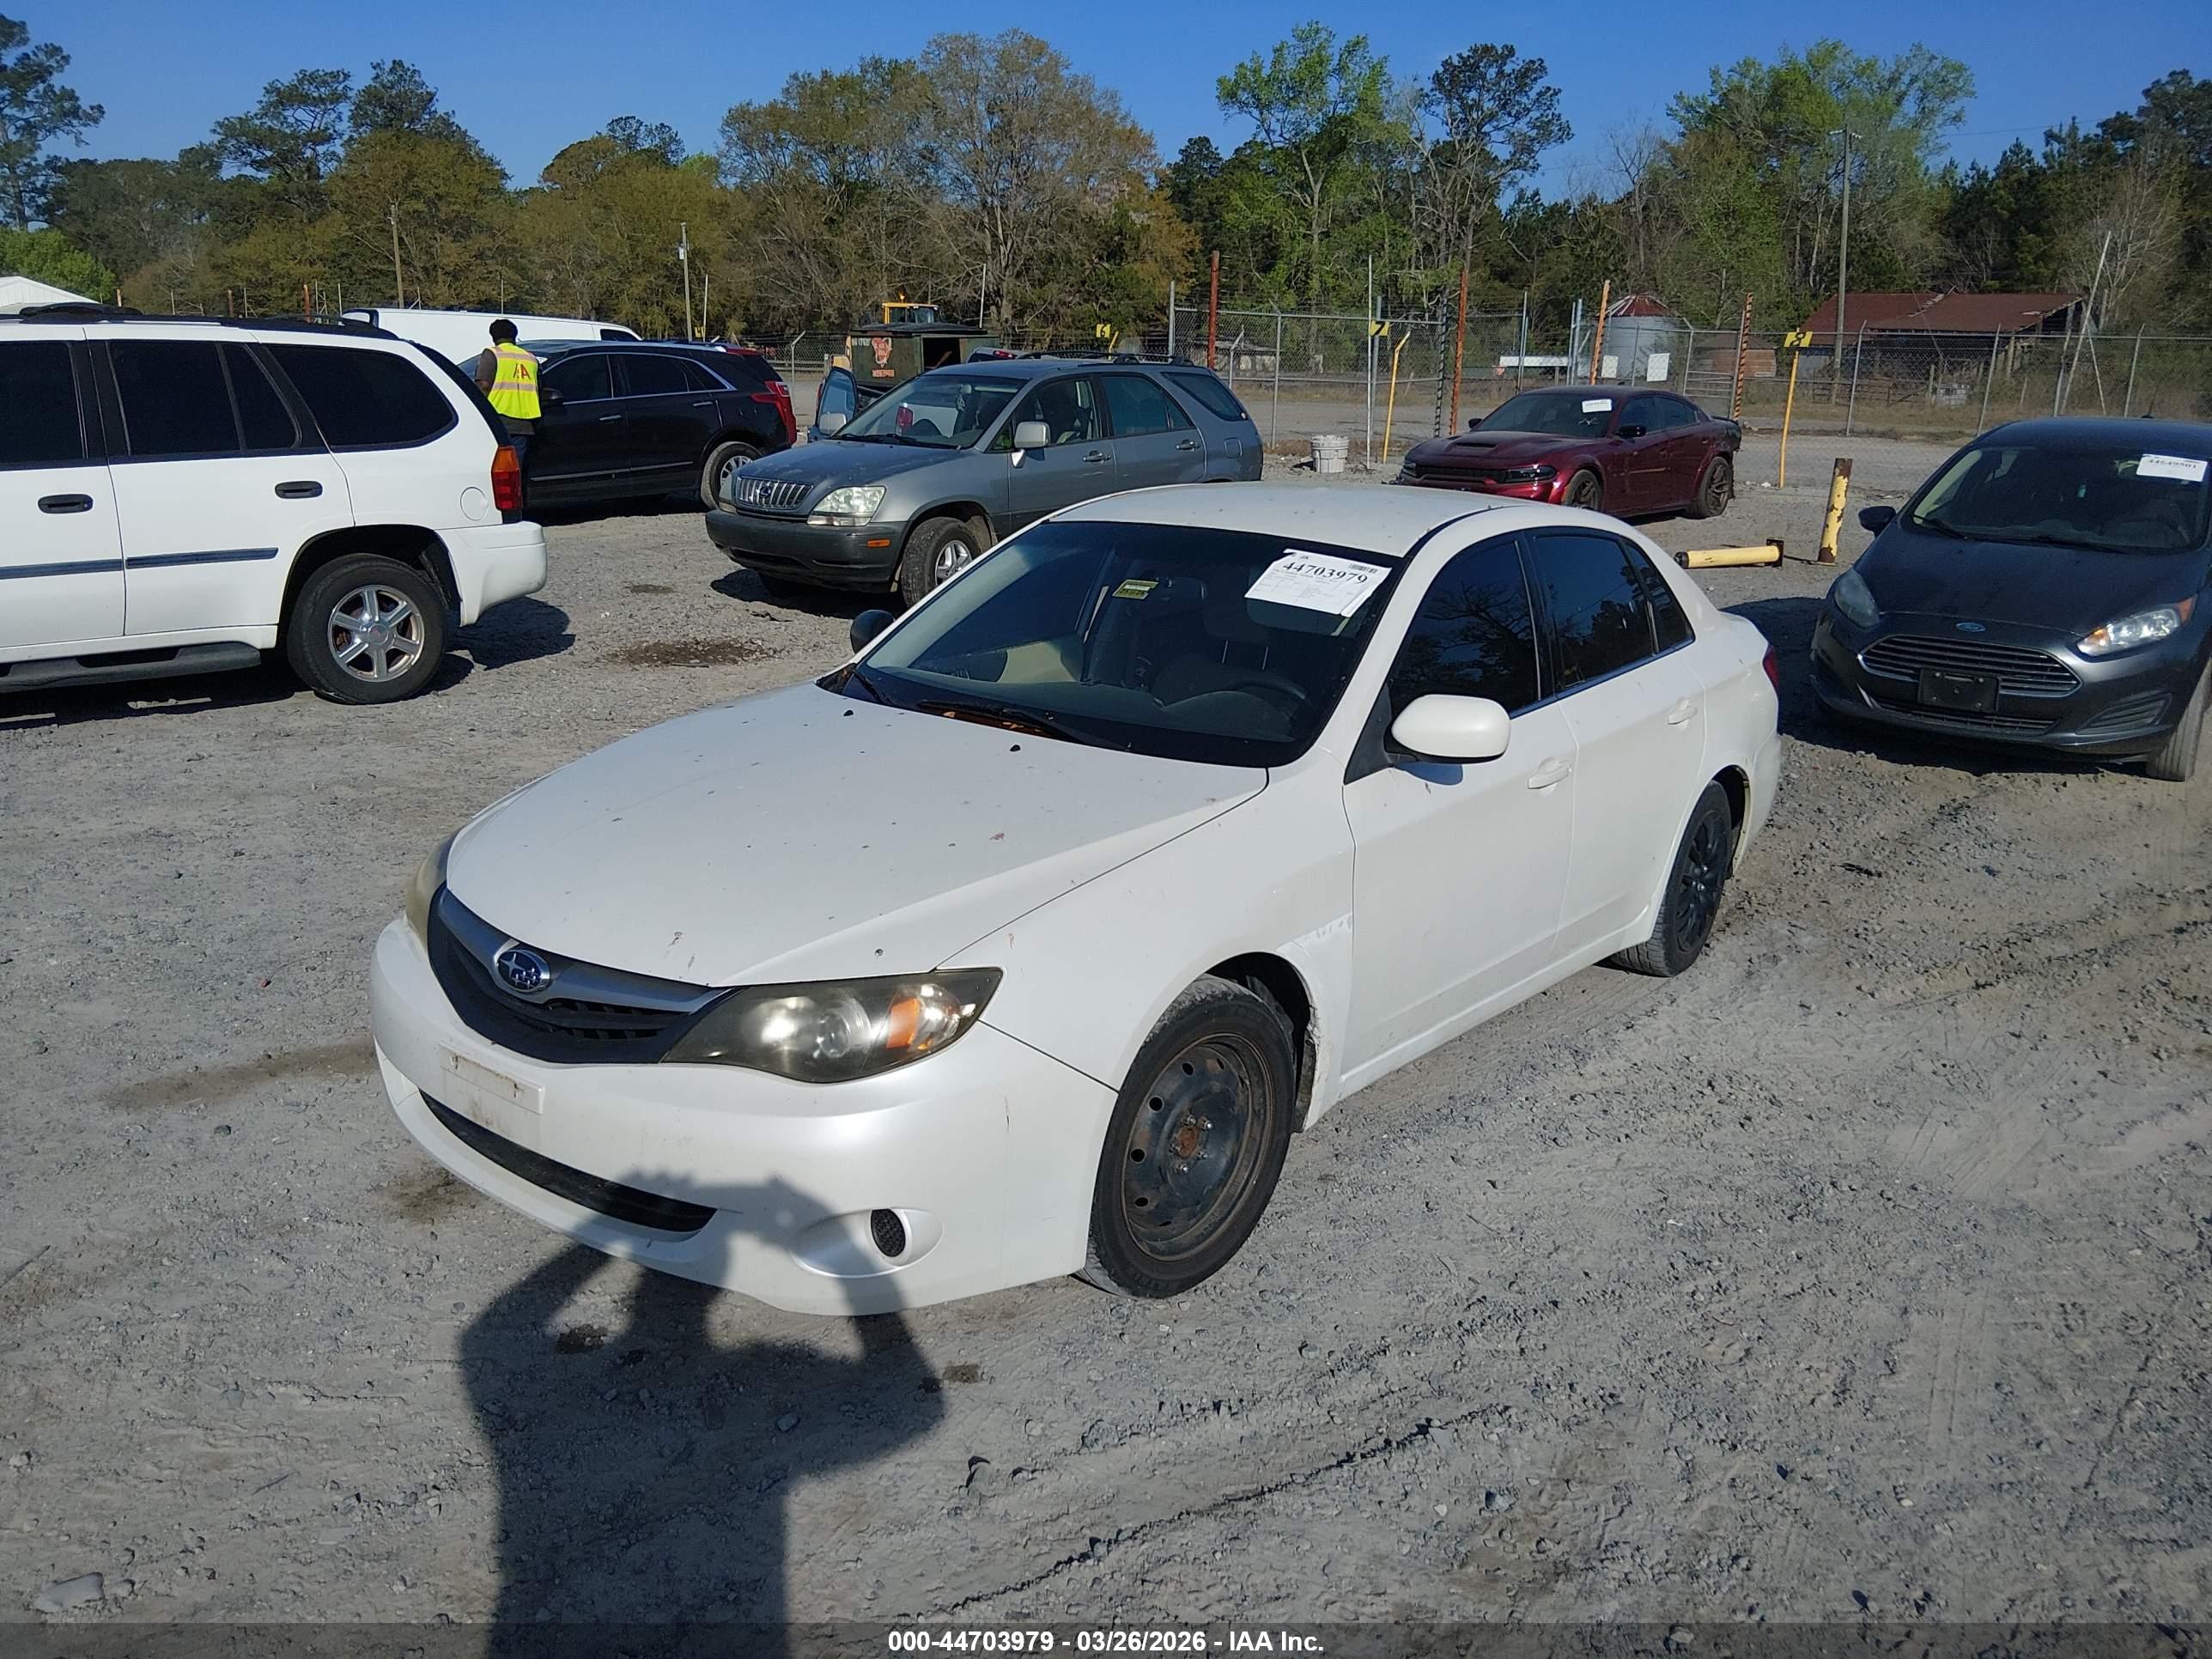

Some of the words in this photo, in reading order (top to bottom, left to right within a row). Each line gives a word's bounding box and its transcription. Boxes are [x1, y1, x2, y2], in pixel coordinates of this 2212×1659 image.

[1373, 321, 1386, 337] 7
[1790, 331, 1807, 347] 8
[1283, 562, 1369, 585] 44703979
